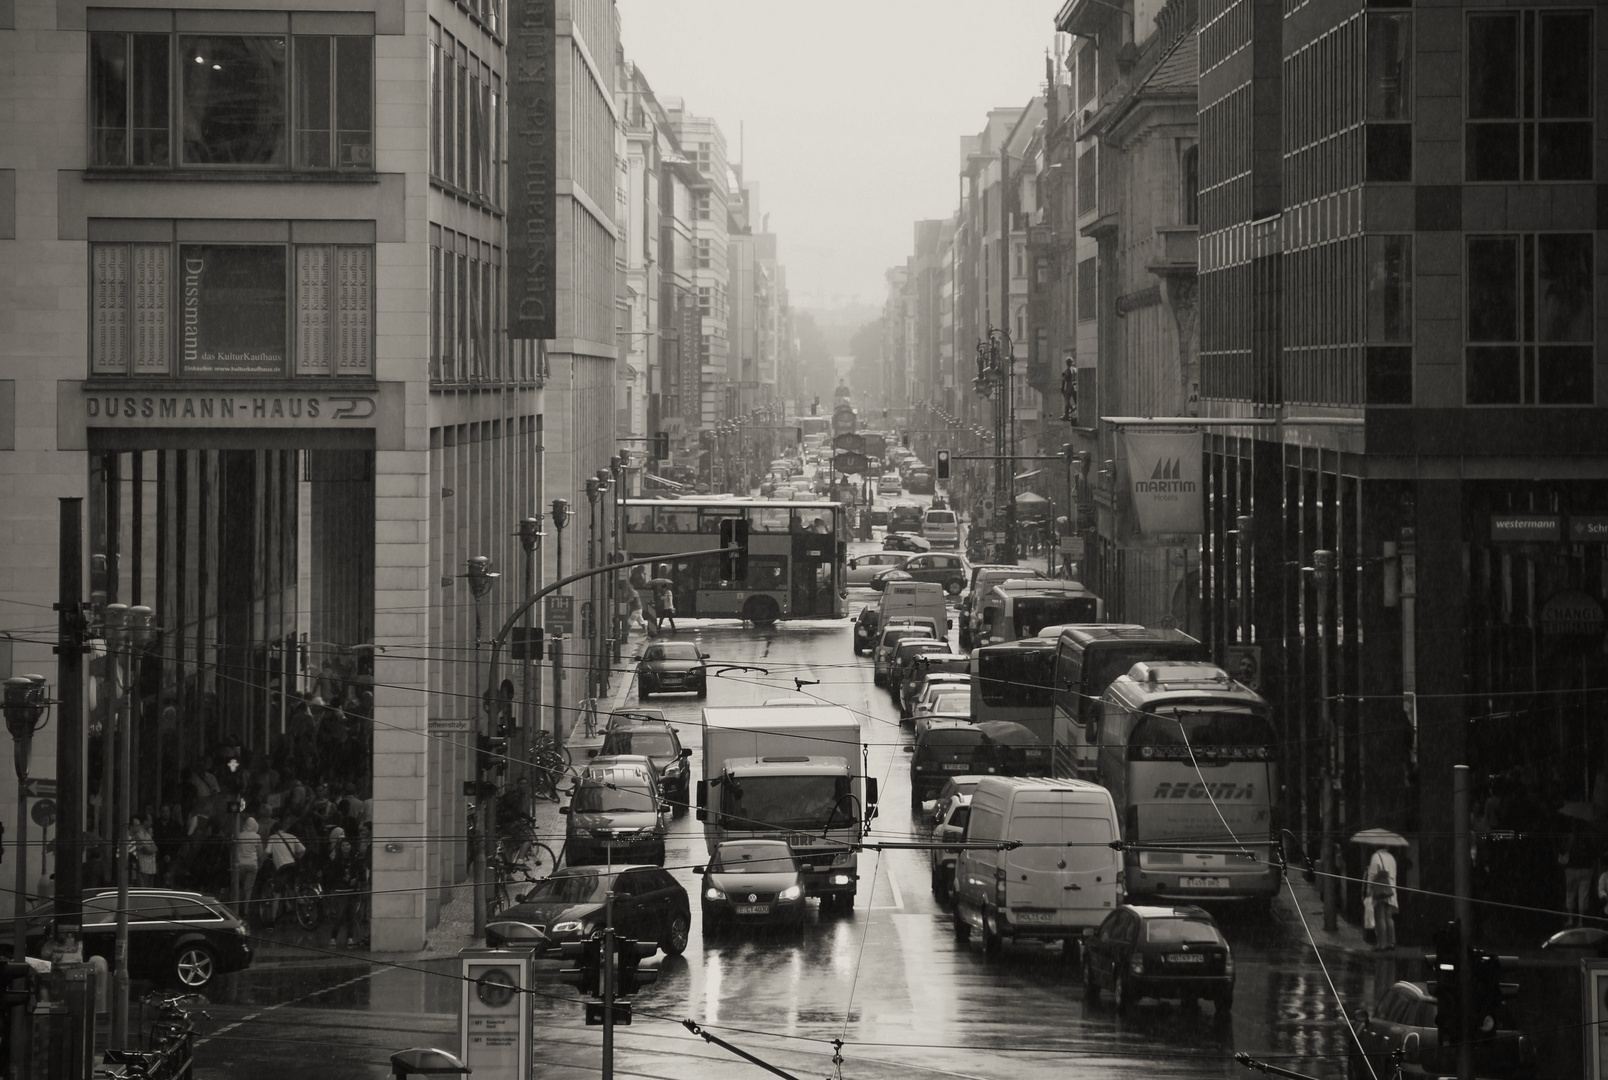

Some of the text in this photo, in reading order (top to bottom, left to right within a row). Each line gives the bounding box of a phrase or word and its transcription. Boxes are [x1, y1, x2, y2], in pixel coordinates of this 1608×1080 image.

[519, 97, 545, 146] das
[519, 159, 546, 322] Dussmann
[108, 248, 116, 366] Dussmann das KulturKaufhaus
[147, 248, 155, 366] Dussmann das KulturKaufhaus
[157, 248, 165, 366] Dussmann das KulturKaufhaus
[185, 258, 204, 360] Dussmann
[201, 352, 282, 361] das KulturKaufhaus
[311, 250, 319, 368] Dussmann das KulturKaufhaus
[321, 250, 329, 368] Dussmann das KulturKaufhaus
[359, 250, 367, 368] Dussmann das KulturKaufhaus
[86, 397, 320, 419] DUSSMANN-HAUS
[1135, 480, 1196, 493] MARITIM
[1153, 493, 1179, 502] Hotels
[1495, 519, 1556, 529] westermann
